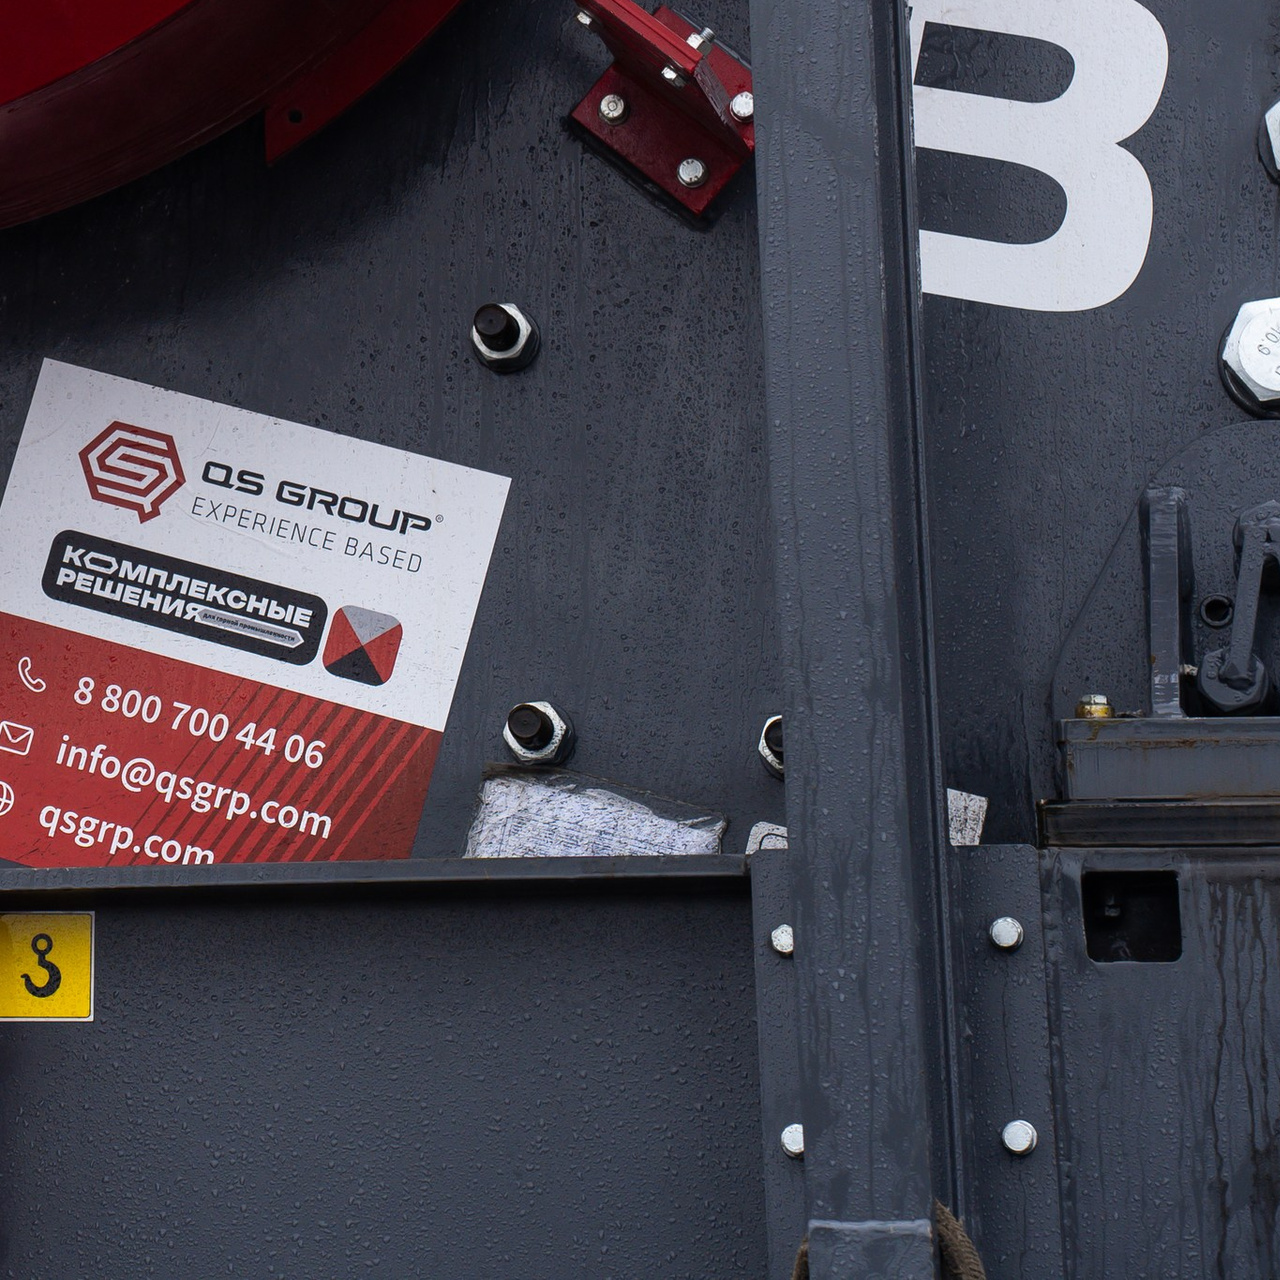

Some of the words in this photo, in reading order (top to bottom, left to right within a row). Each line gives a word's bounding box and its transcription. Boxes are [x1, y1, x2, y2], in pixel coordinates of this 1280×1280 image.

[201, 461, 265, 496] QS
[191, 496, 338, 551] EXPERIENCE
[344, 536, 423, 573] BASED
[55, 567, 203, 622] РЕШЕНИЯ
[62, 545, 313, 628] КОМПЛЕКСНЫЕ
[73, 676, 95, 705] 8
[101, 684, 162, 724] 800
[171, 701, 230, 742] 700
[235, 722, 277, 756] 44
[284, 734, 326, 769] 06
[56, 734, 332, 839] info@qsgrp.com
[38, 805, 215, 865] qsgrp.com
